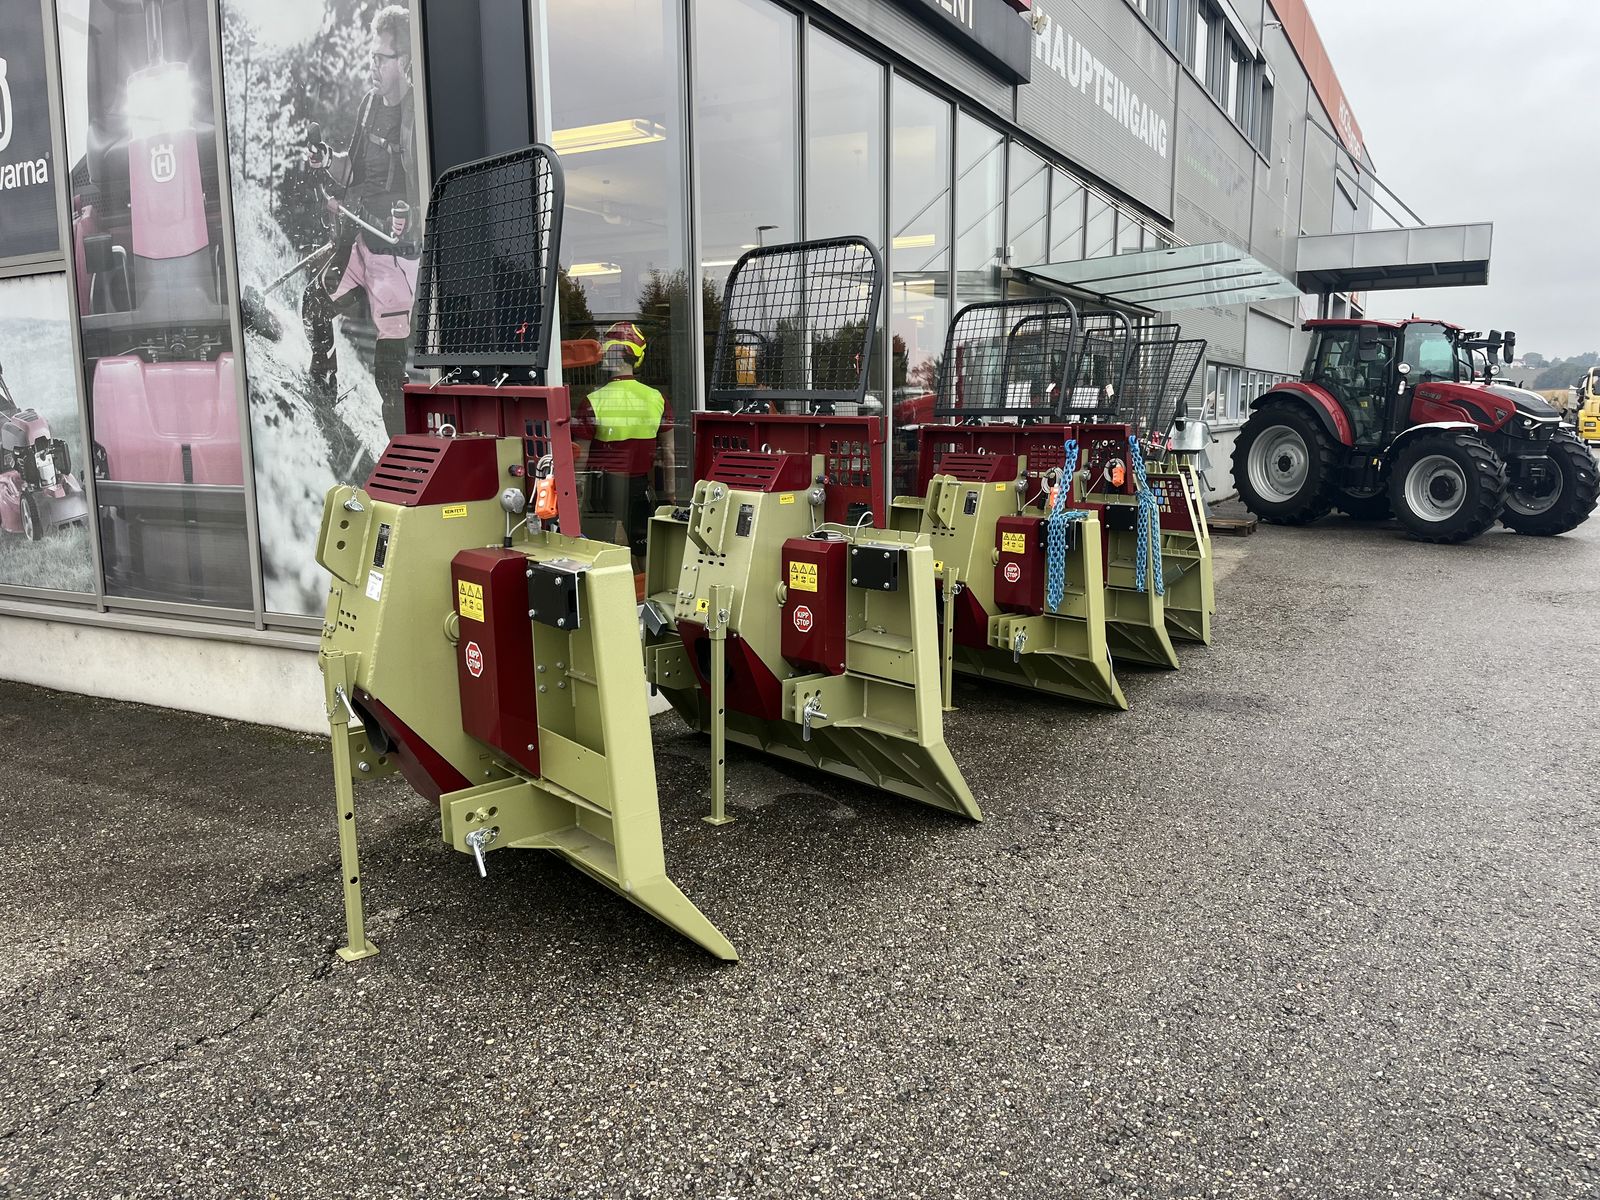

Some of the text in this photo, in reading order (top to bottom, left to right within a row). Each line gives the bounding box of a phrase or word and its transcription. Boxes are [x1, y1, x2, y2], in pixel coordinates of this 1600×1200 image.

[1036, 6, 1167, 160] HAUPTEINGANG
[796, 618, 810, 627] STOP
[468, 649, 480, 659] KIPP
[468, 658, 481, 670] STOP
